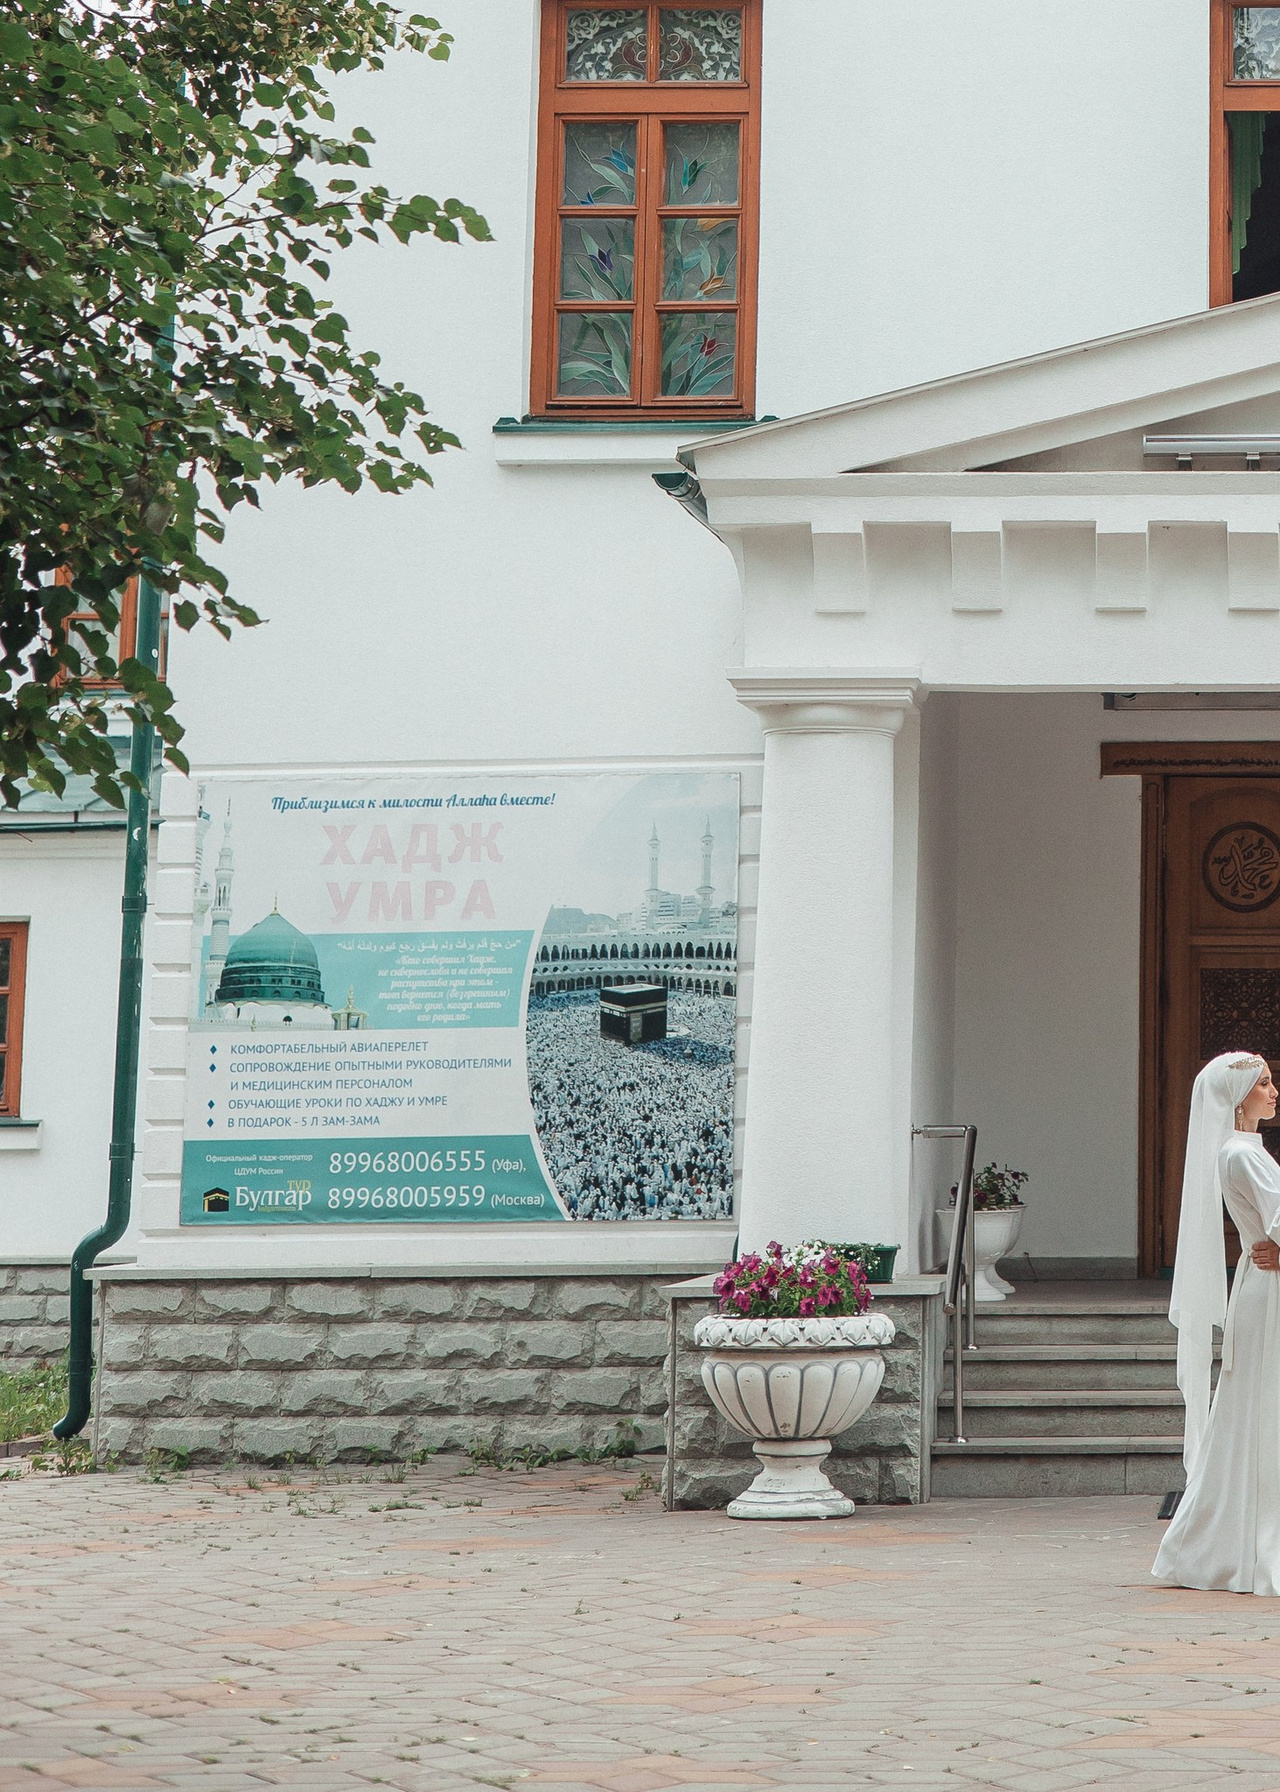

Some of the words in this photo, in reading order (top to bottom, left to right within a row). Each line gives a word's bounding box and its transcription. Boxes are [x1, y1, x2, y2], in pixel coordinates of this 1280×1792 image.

[271, 796, 365, 814] Приблизимся
[367, 798, 377, 809] к
[379, 797, 443, 809] милости
[499, 793, 556, 806] вместе!
[320, 821, 505, 874] ХАДЖ
[325, 879, 497, 925] УМРА
[230, 1041, 347, 1055] КОМФОРТАБЕЛЬНЫЙ
[350, 1041, 429, 1053] АВИАПЕРЕЛЕТ
[229, 1061, 331, 1074] СОПРОВОЖДЕНИЕ
[334, 1060, 403, 1072] ОПЫТНЫМИ
[406, 1058, 512, 1070] РУКОВОДИТЕЛЯМИ
[230, 1081, 239, 1091] И
[242, 1080, 333, 1092] МЕДИЦИНСКИМ
[335, 1078, 413, 1090] ПЕРСОНАЛОМ
[228, 1099, 302, 1112] ОБУЧАЮЩИЕ
[305, 1098, 343, 1109] УРОКИ
[345, 1097, 362, 1108] ПО
[365, 1096, 405, 1108] ХАДЖУ
[407, 1097, 415, 1106] И
[418, 1095, 448, 1106] УМРЕ
[227, 1118, 235, 1128] В
[238, 1117, 292, 1129] ПОДАРОК
[301, 1117, 308, 1127] 5
[310, 1117, 319, 1126] Л
[321, 1115, 381, 1127] ЗАМ-ЗАМА
[205, 1154, 257, 1164] Официальный
[258, 1154, 313, 1162] хадж-оператор
[329, 1150, 486, 1174] 89968006555
[491, 1158, 526, 1173] (Уфа),
[234, 1168, 257, 1176] ЦДУМ
[235, 1186, 312, 1211] Булгар
[327, 1184, 486, 1209] 89968005959
[490, 1194, 545, 1208] (Москва)
